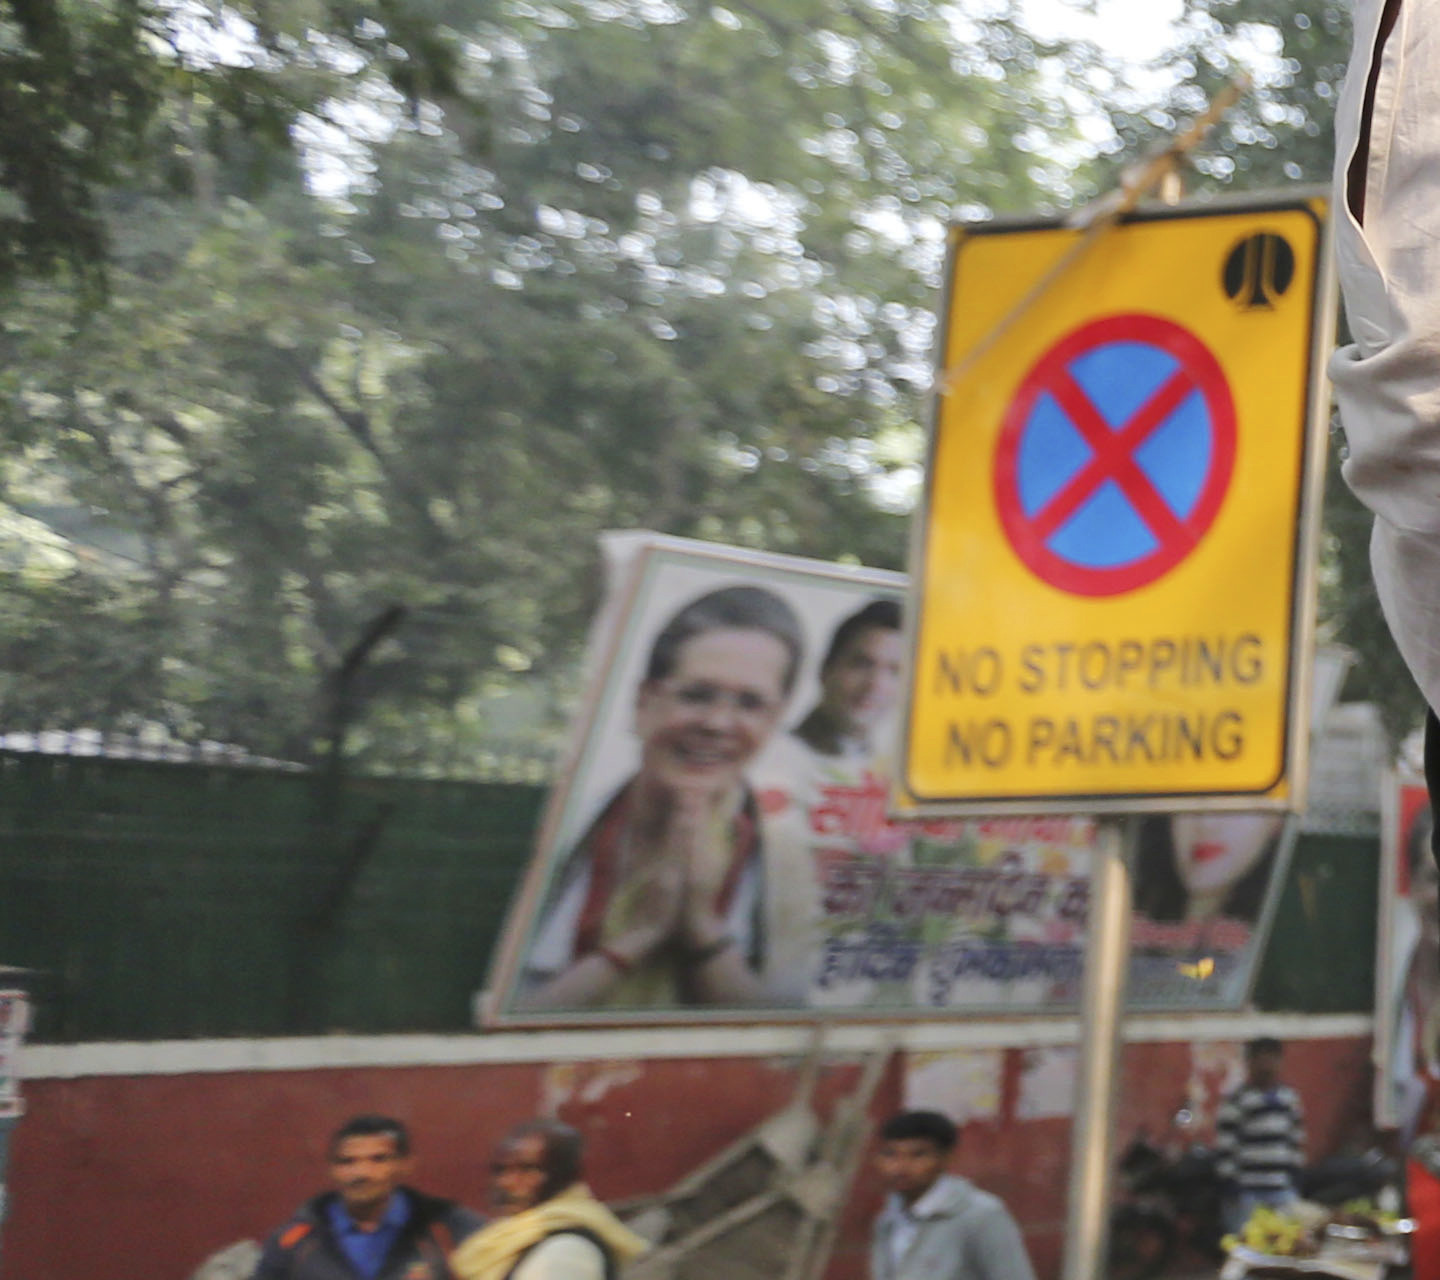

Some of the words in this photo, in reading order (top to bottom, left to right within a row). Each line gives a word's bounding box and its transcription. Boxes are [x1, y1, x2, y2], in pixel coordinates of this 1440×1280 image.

[935, 646, 1001, 698] NO
[1019, 634, 1263, 693] STOPPING
[944, 720, 1012, 769] NO
[1027, 711, 1244, 764] PARKING
